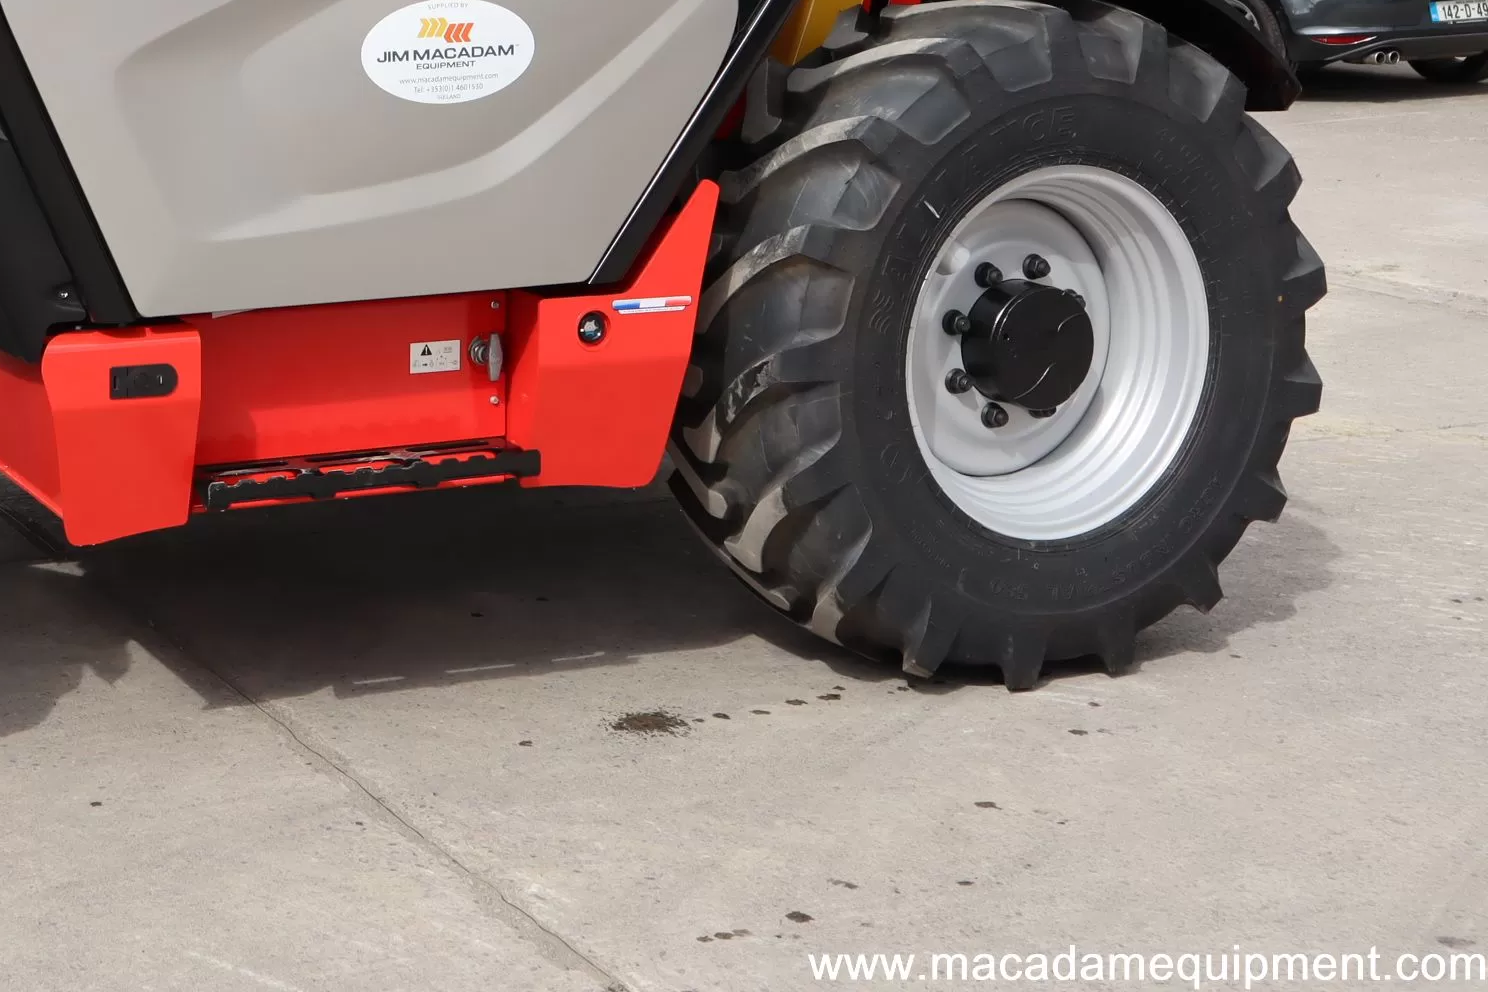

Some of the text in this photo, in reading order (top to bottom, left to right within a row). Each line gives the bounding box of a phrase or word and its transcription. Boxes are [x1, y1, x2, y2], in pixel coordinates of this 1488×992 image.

[376, 44, 515, 63] JIM MACADAM
[416, 60, 476, 70] EQUIPMENT
[399, 72, 499, 84] www.macadamequipment.com
